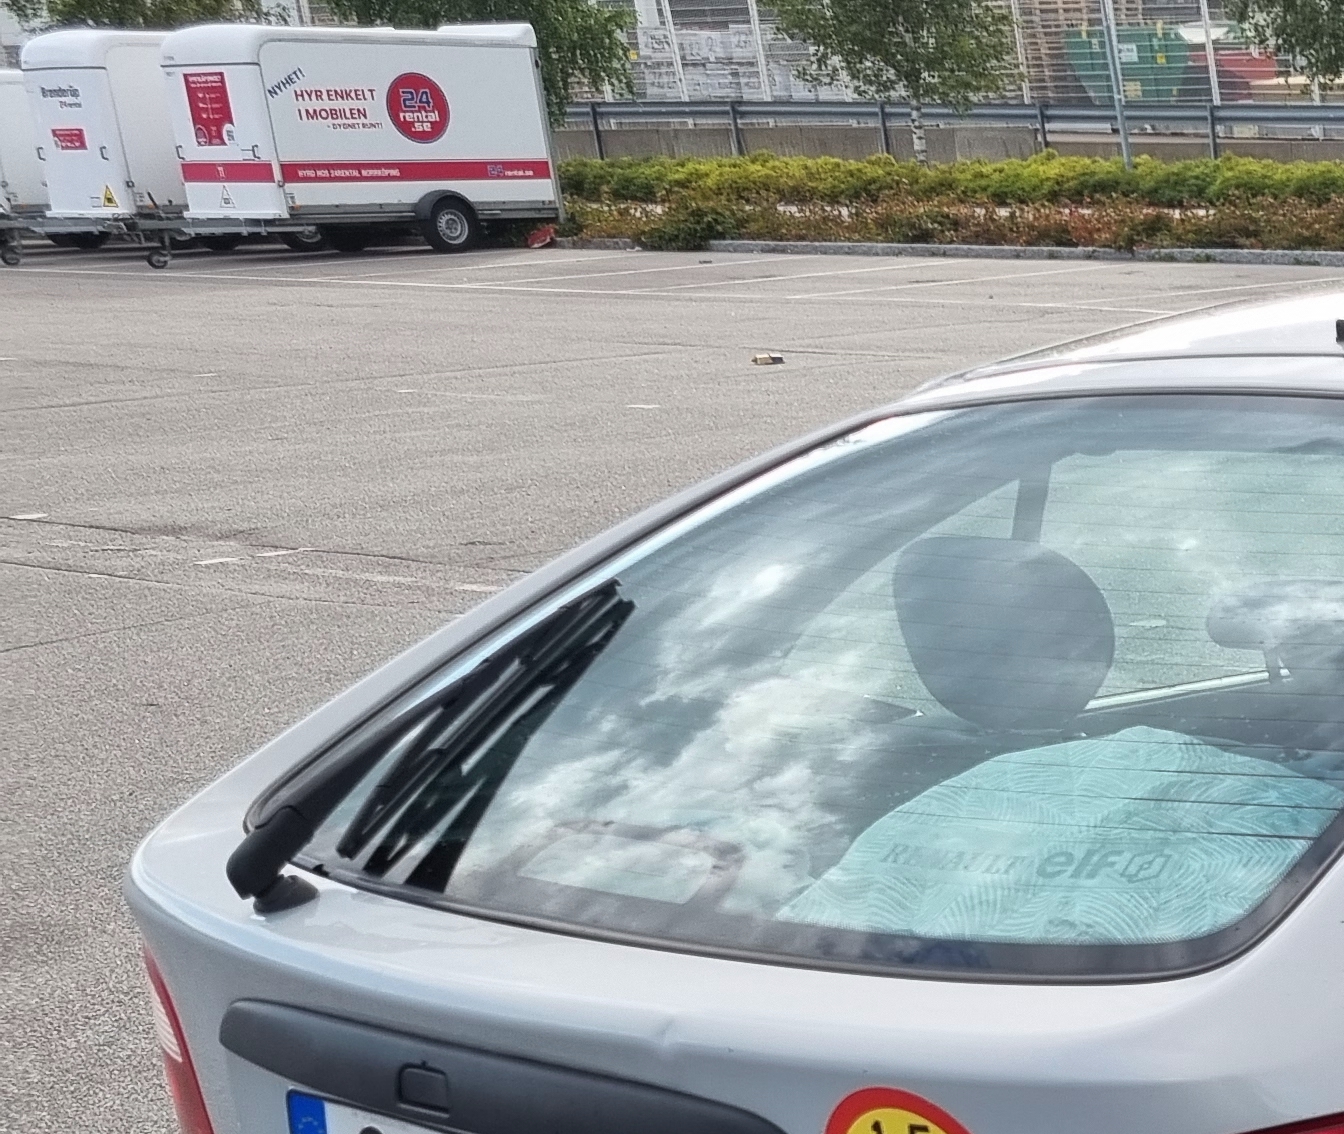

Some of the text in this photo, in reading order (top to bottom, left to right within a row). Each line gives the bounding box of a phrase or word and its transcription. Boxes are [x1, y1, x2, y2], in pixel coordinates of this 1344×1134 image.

[267, 67, 306, 99] NYHET!
[294, 88, 376, 102] HYR ENKELT
[399, 88, 434, 111] 24
[305, 107, 368, 121] MOBILEN
[399, 110, 440, 122] rental
